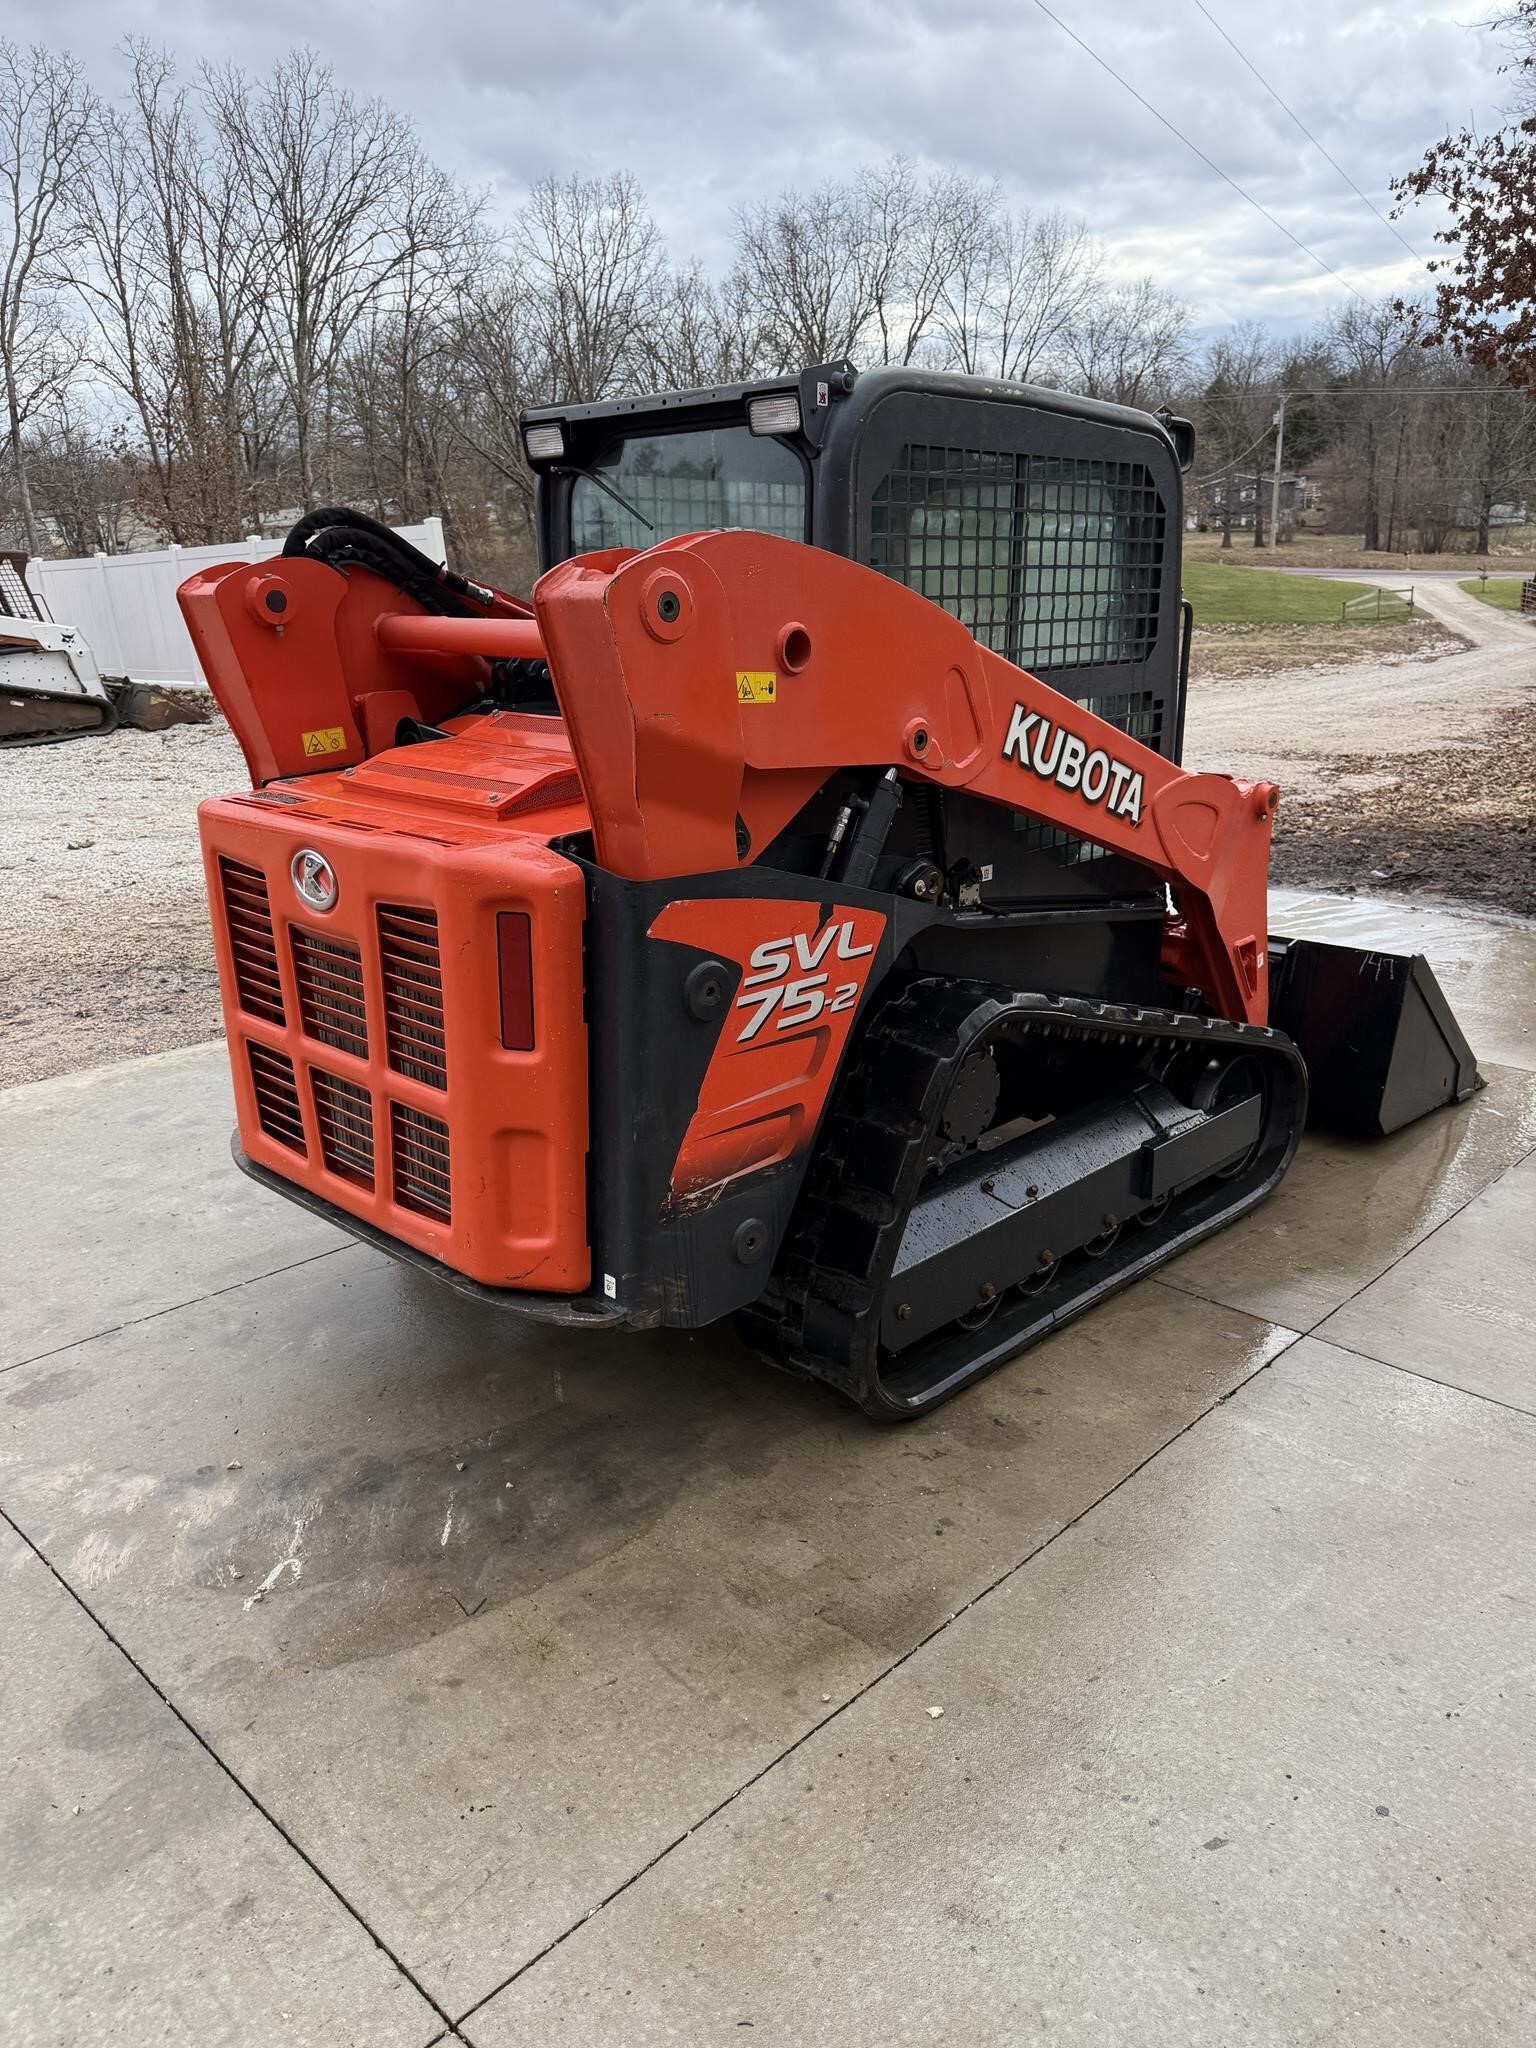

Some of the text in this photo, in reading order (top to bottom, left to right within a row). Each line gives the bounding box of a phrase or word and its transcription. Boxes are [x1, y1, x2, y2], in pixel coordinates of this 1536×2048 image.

[1002, 702, 1144, 823] KUBOTA
[744, 921, 873, 987] SVL
[736, 972, 859, 1043] 75-2
